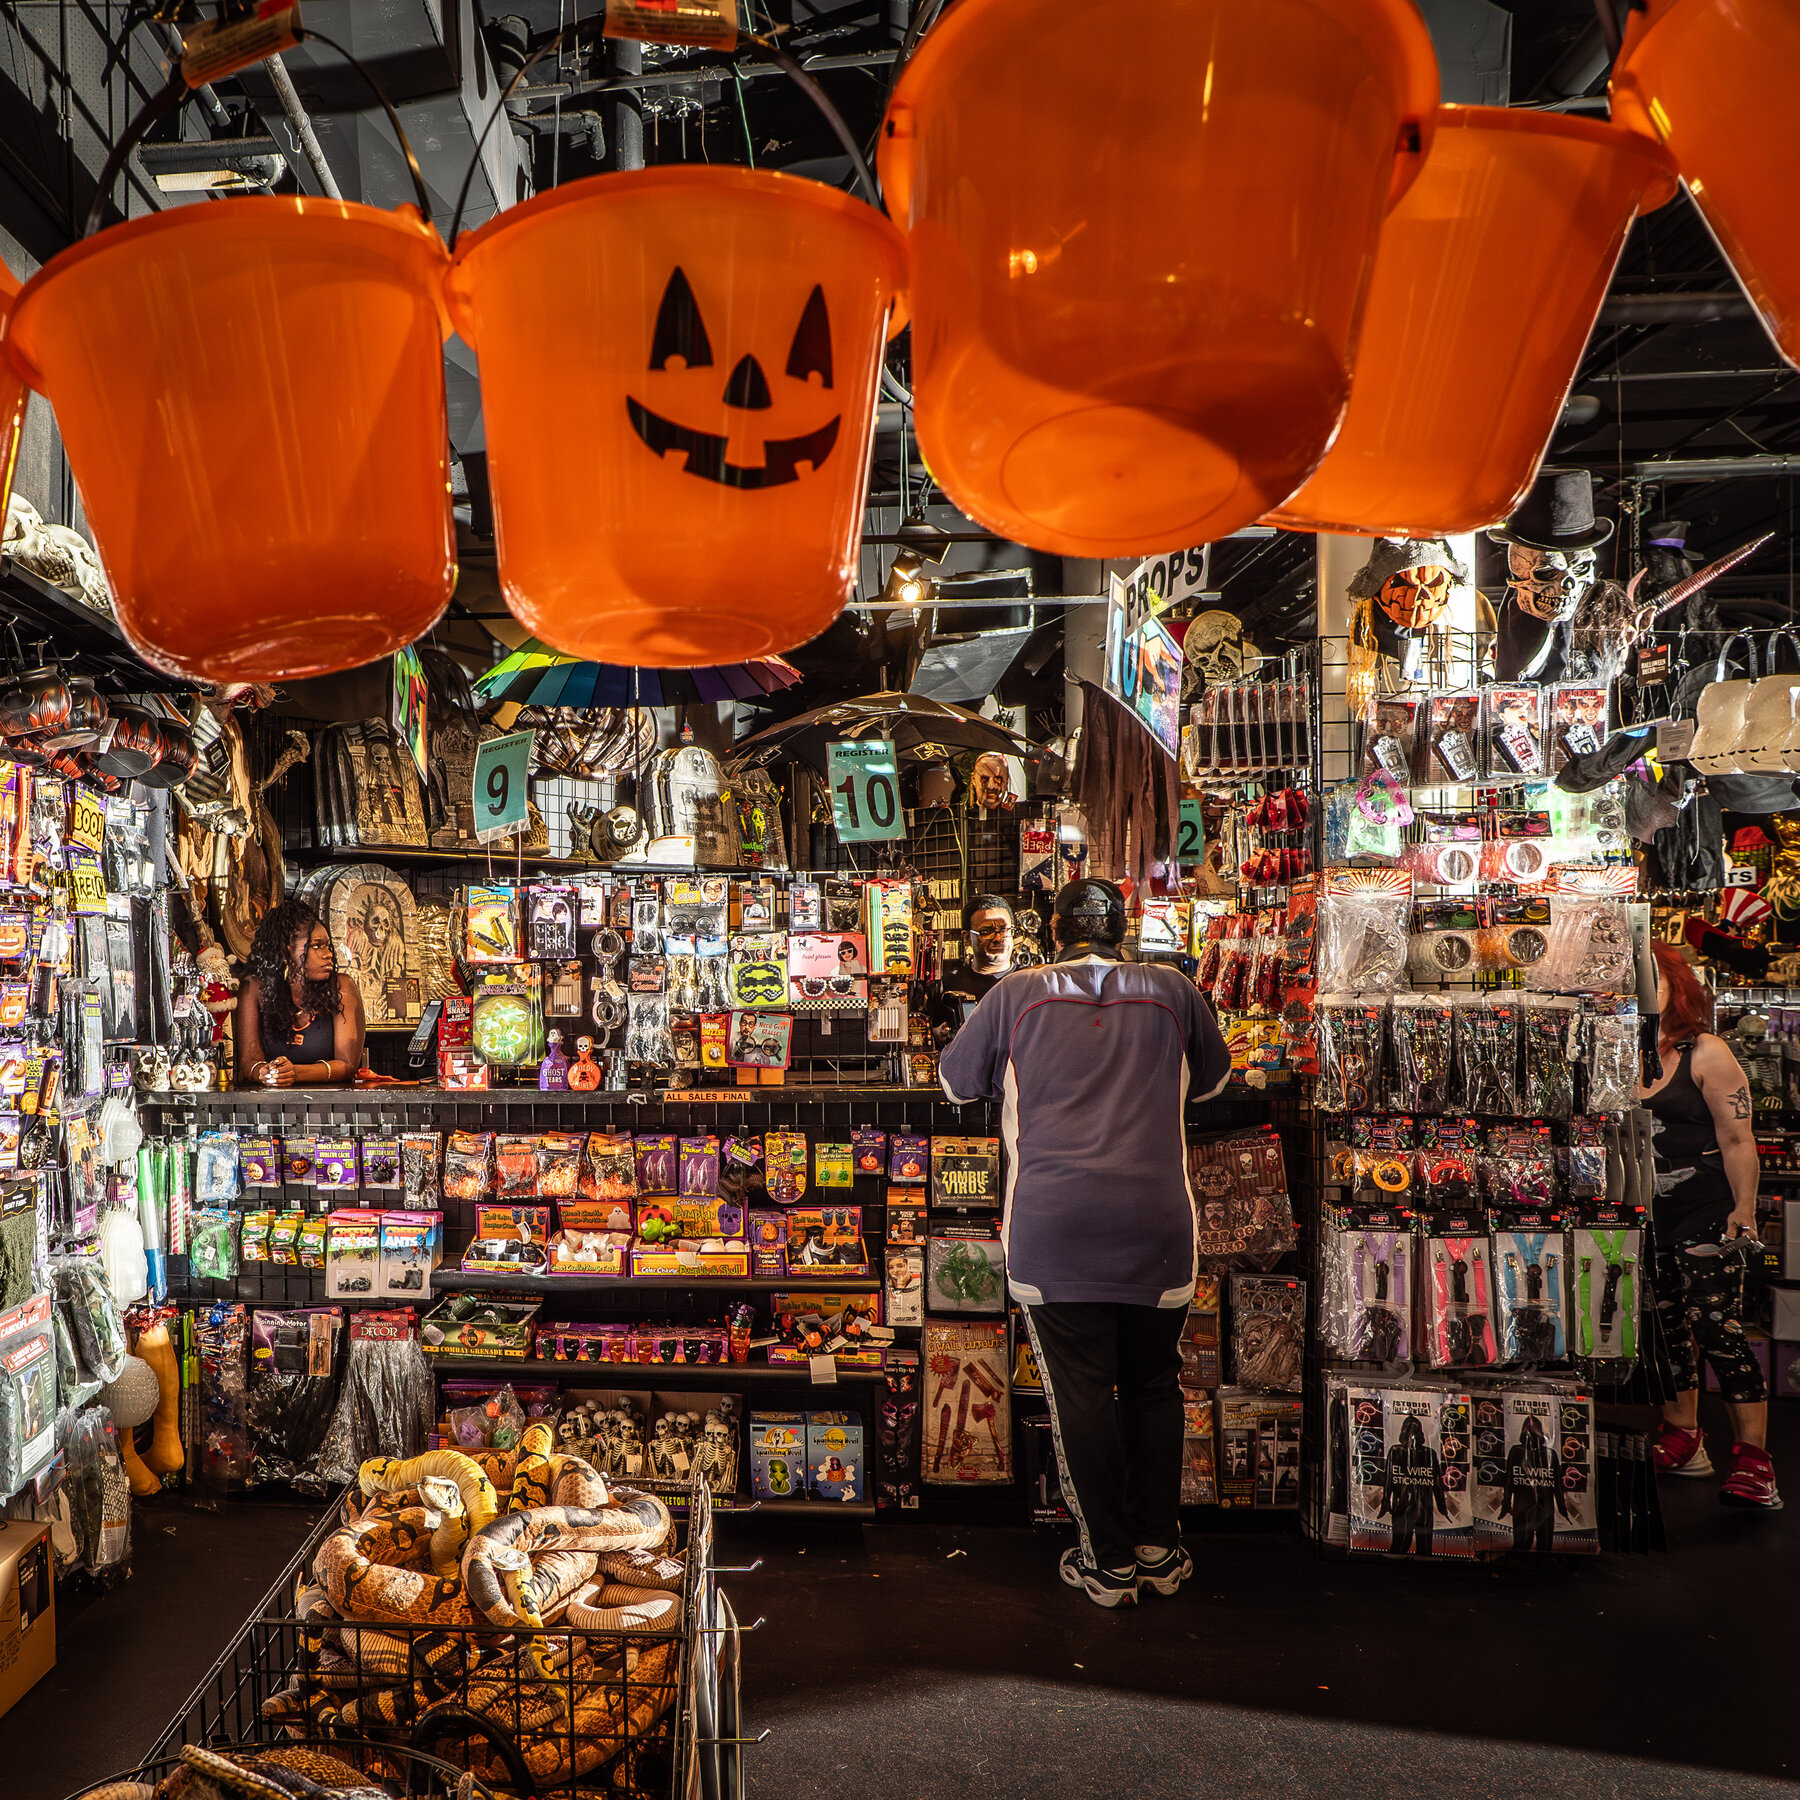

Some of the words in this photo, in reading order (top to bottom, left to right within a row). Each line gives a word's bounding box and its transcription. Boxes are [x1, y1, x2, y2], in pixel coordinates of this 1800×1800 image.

[1125, 546, 1205, 629] PROPS
[482, 737, 528, 755] REGISTER
[835, 748, 889, 758] REGISTER
[486, 764, 509, 816] 9
[836, 774, 896, 829] 10
[75, 803, 105, 842] BOO!
[543, 1069, 565, 1077] GHOST
[682, 1146, 702, 1154] Flicker
[941, 1170, 989, 1184] ZOMBIE
[944, 1180, 987, 1195] VIRUS
[673, 1205, 717, 1222] Pumpkin
[332, 1227, 376, 1237] CREEPY
[384, 1227, 429, 1237] CREEPY
[682, 1221, 713, 1238] Skull
[384, 1237, 418, 1247] ANTS
[679, 1265, 710, 1277] Pumpkin
[719, 1264, 741, 1275] Skull
[0, 1312, 40, 1339] CAMOUFLAGE
[287, 1319, 308, 1328] Motor
[361, 1327, 398, 1338] DECOR
[936, 1341, 962, 1351] WALL
[963, 1338, 1007, 1350] CUTOUTS
[440, 1346, 469, 1354] COMBAT
[470, 1347, 503, 1356] GRENADE
[1515, 1400, 1550, 1408] STUDIO
[1392, 1466, 1405, 1476] EL
[1406, 1466, 1433, 1477] WIRE
[1513, 1466, 1526, 1476] EL
[1527, 1466, 1555, 1479] WIRE
[1392, 1476, 1435, 1487] STICKMAN
[1513, 1477, 1555, 1488] STICKMAN
